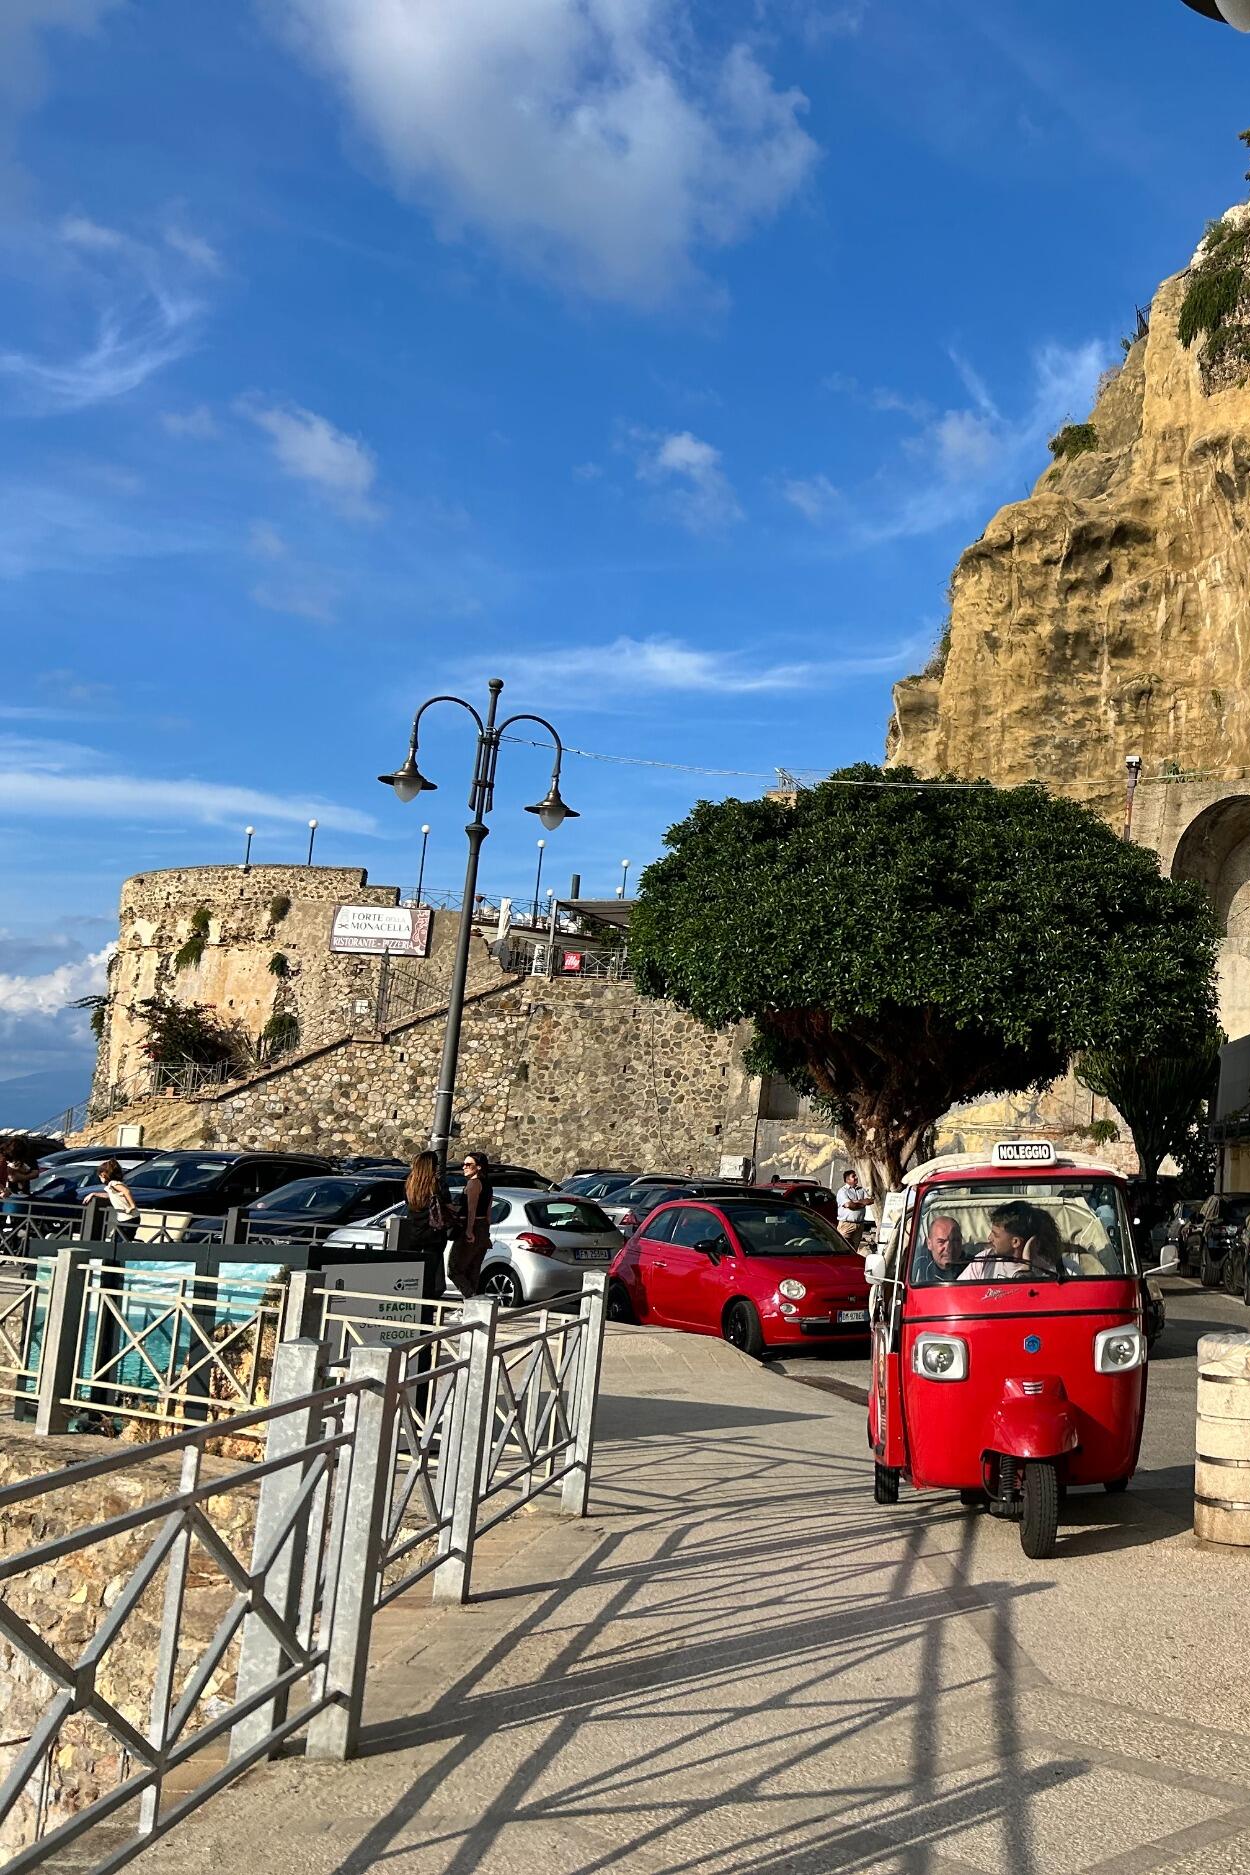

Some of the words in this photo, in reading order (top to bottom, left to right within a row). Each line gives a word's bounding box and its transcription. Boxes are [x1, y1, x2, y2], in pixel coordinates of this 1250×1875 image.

[352, 912, 384, 922] FORTE
[351, 921, 411, 932] MONACELLA
[333, 937, 377, 949] RISTORANTE
[382, 939, 415, 950] PIZZERIA
[564, 955, 581, 969] illy
[999, 1145, 1050, 1160] NOLEGGIO
[378, 1303, 384, 1312] 5
[386, 1302, 416, 1312] FACILI
[380, 1330, 415, 1341] REGOLE
